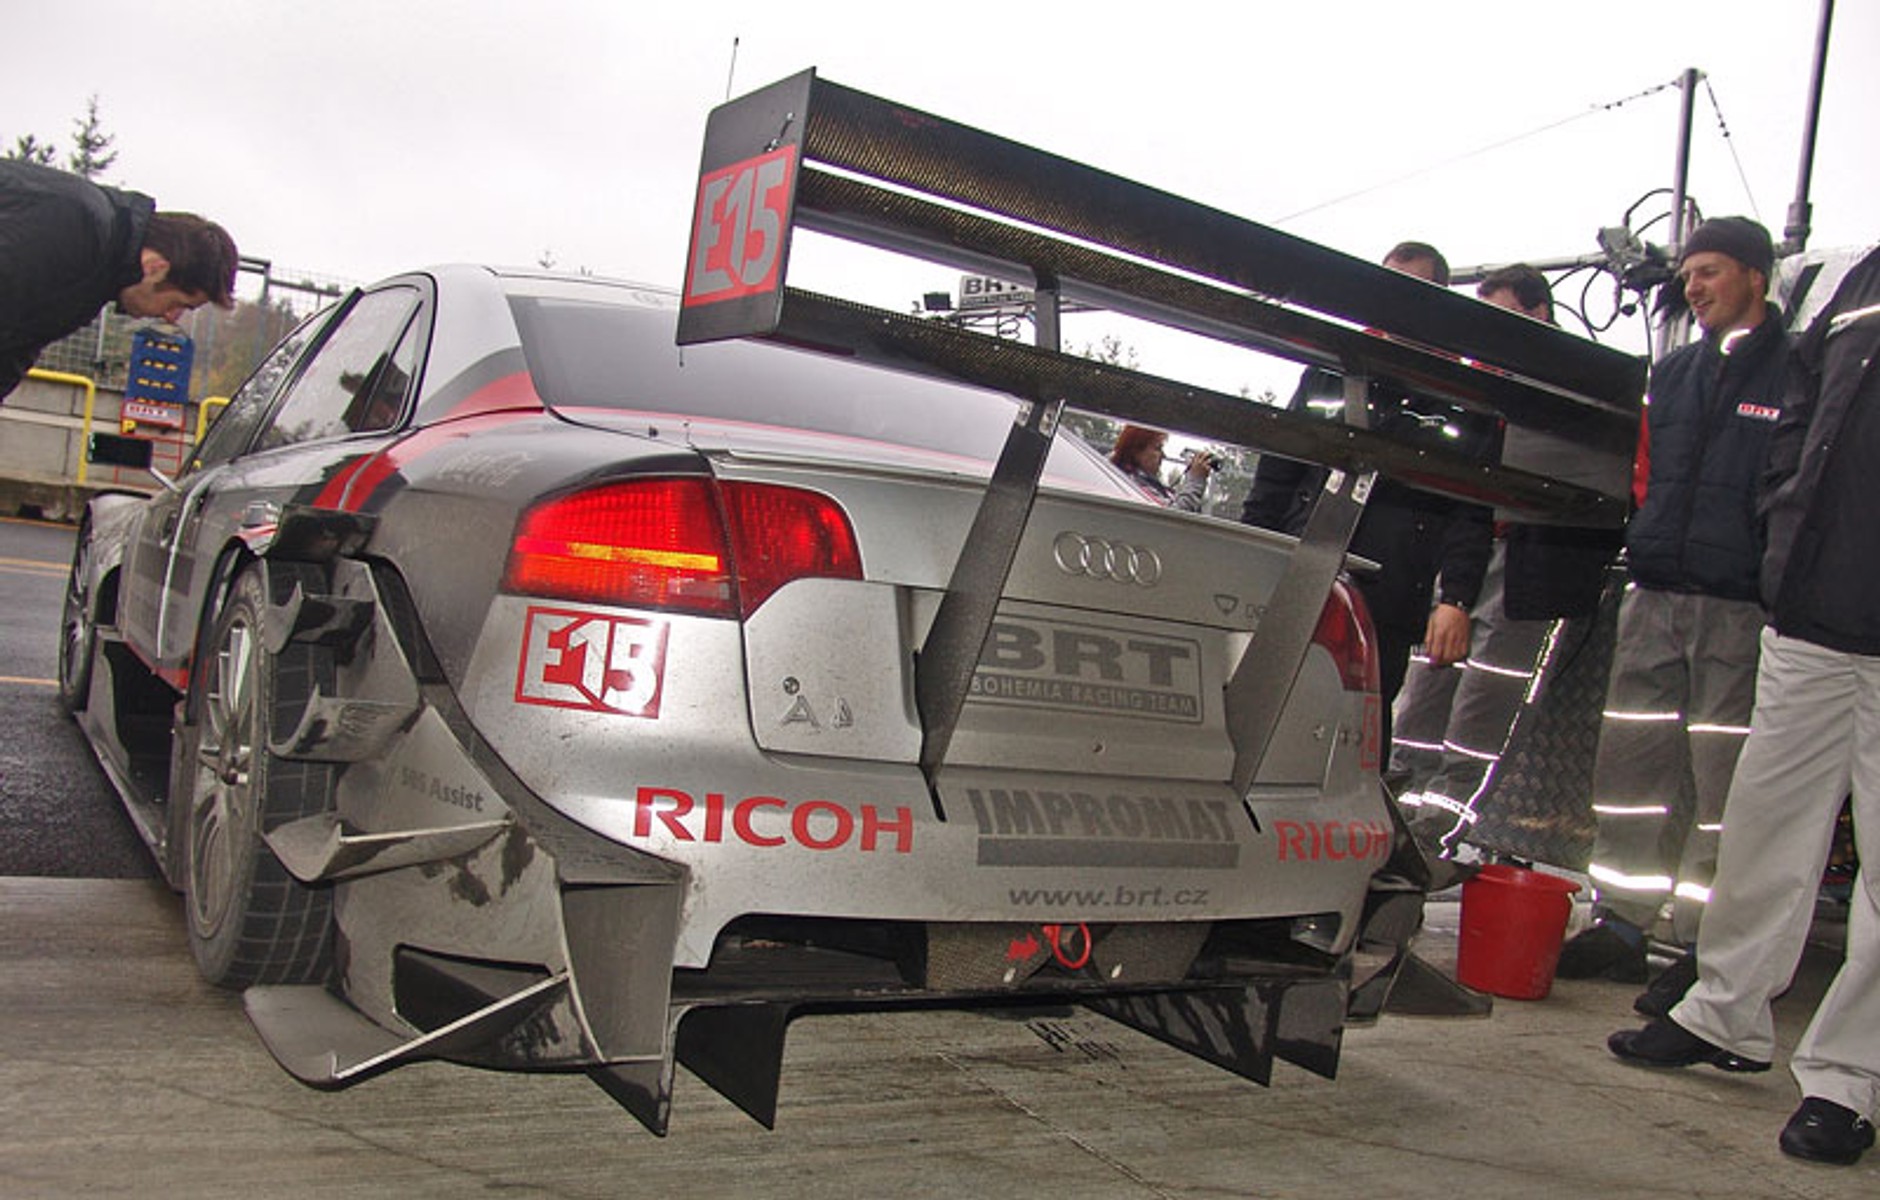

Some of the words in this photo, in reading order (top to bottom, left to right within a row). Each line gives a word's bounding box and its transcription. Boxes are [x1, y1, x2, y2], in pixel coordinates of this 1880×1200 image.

[690, 157, 787, 298] E15
[964, 277, 1018, 295] BR
[521, 612, 658, 714] E15
[973, 622, 1190, 687] BRT
[969, 675, 1063, 699] BOHEMIA
[1071, 685, 1144, 709] RACING
[1151, 693, 1198, 714] TEAM
[429, 777, 485, 813] Assist
[966, 788, 1236, 842] IMPROMAT
[633, 787, 914, 854] RICOH
[1274, 819, 1390, 861] RICOH
[1008, 885, 1209, 907] www.brt.cz
